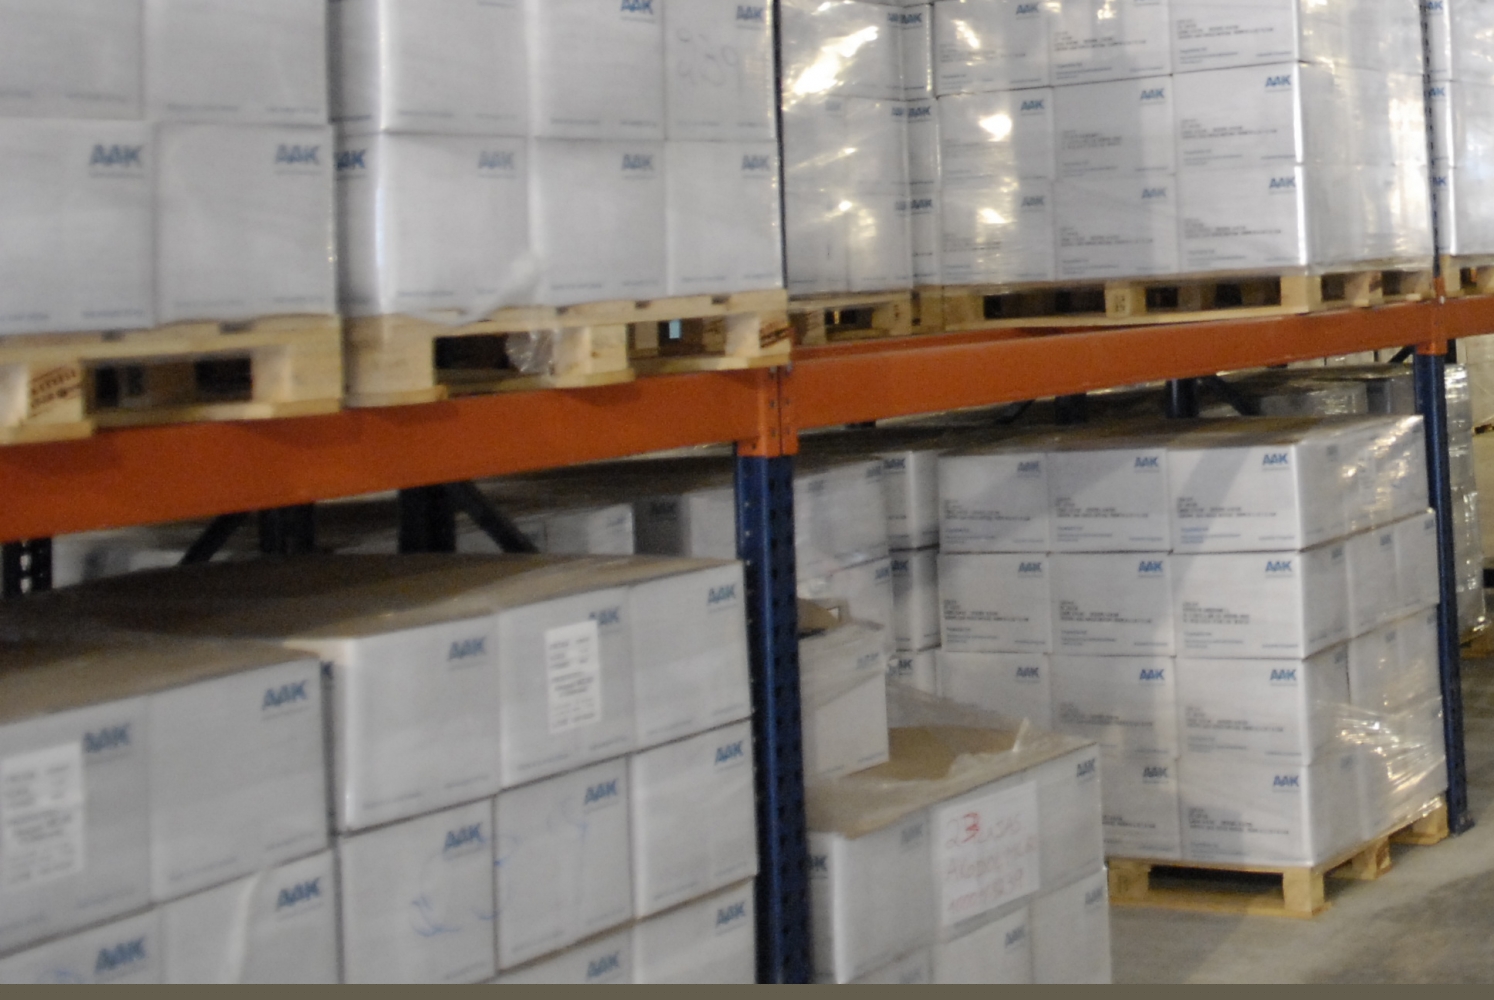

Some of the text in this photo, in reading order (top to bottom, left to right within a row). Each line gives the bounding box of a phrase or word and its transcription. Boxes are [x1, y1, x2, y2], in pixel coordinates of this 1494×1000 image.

[736, 4, 764, 22] AAK
[1265, 74, 1292, 89] AAK
[1269, 176, 1296, 190] AAK
[1134, 455, 1160, 469] AAK
[1262, 453, 1289, 466] AAK
[1138, 560, 1164, 573] AAK
[1265, 560, 1293, 573] AAK
[1139, 668, 1165, 681] AAK
[1270, 668, 1298, 682] AAK
[1143, 766, 1169, 779] AAK
[1273, 775, 1300, 788] AAK
